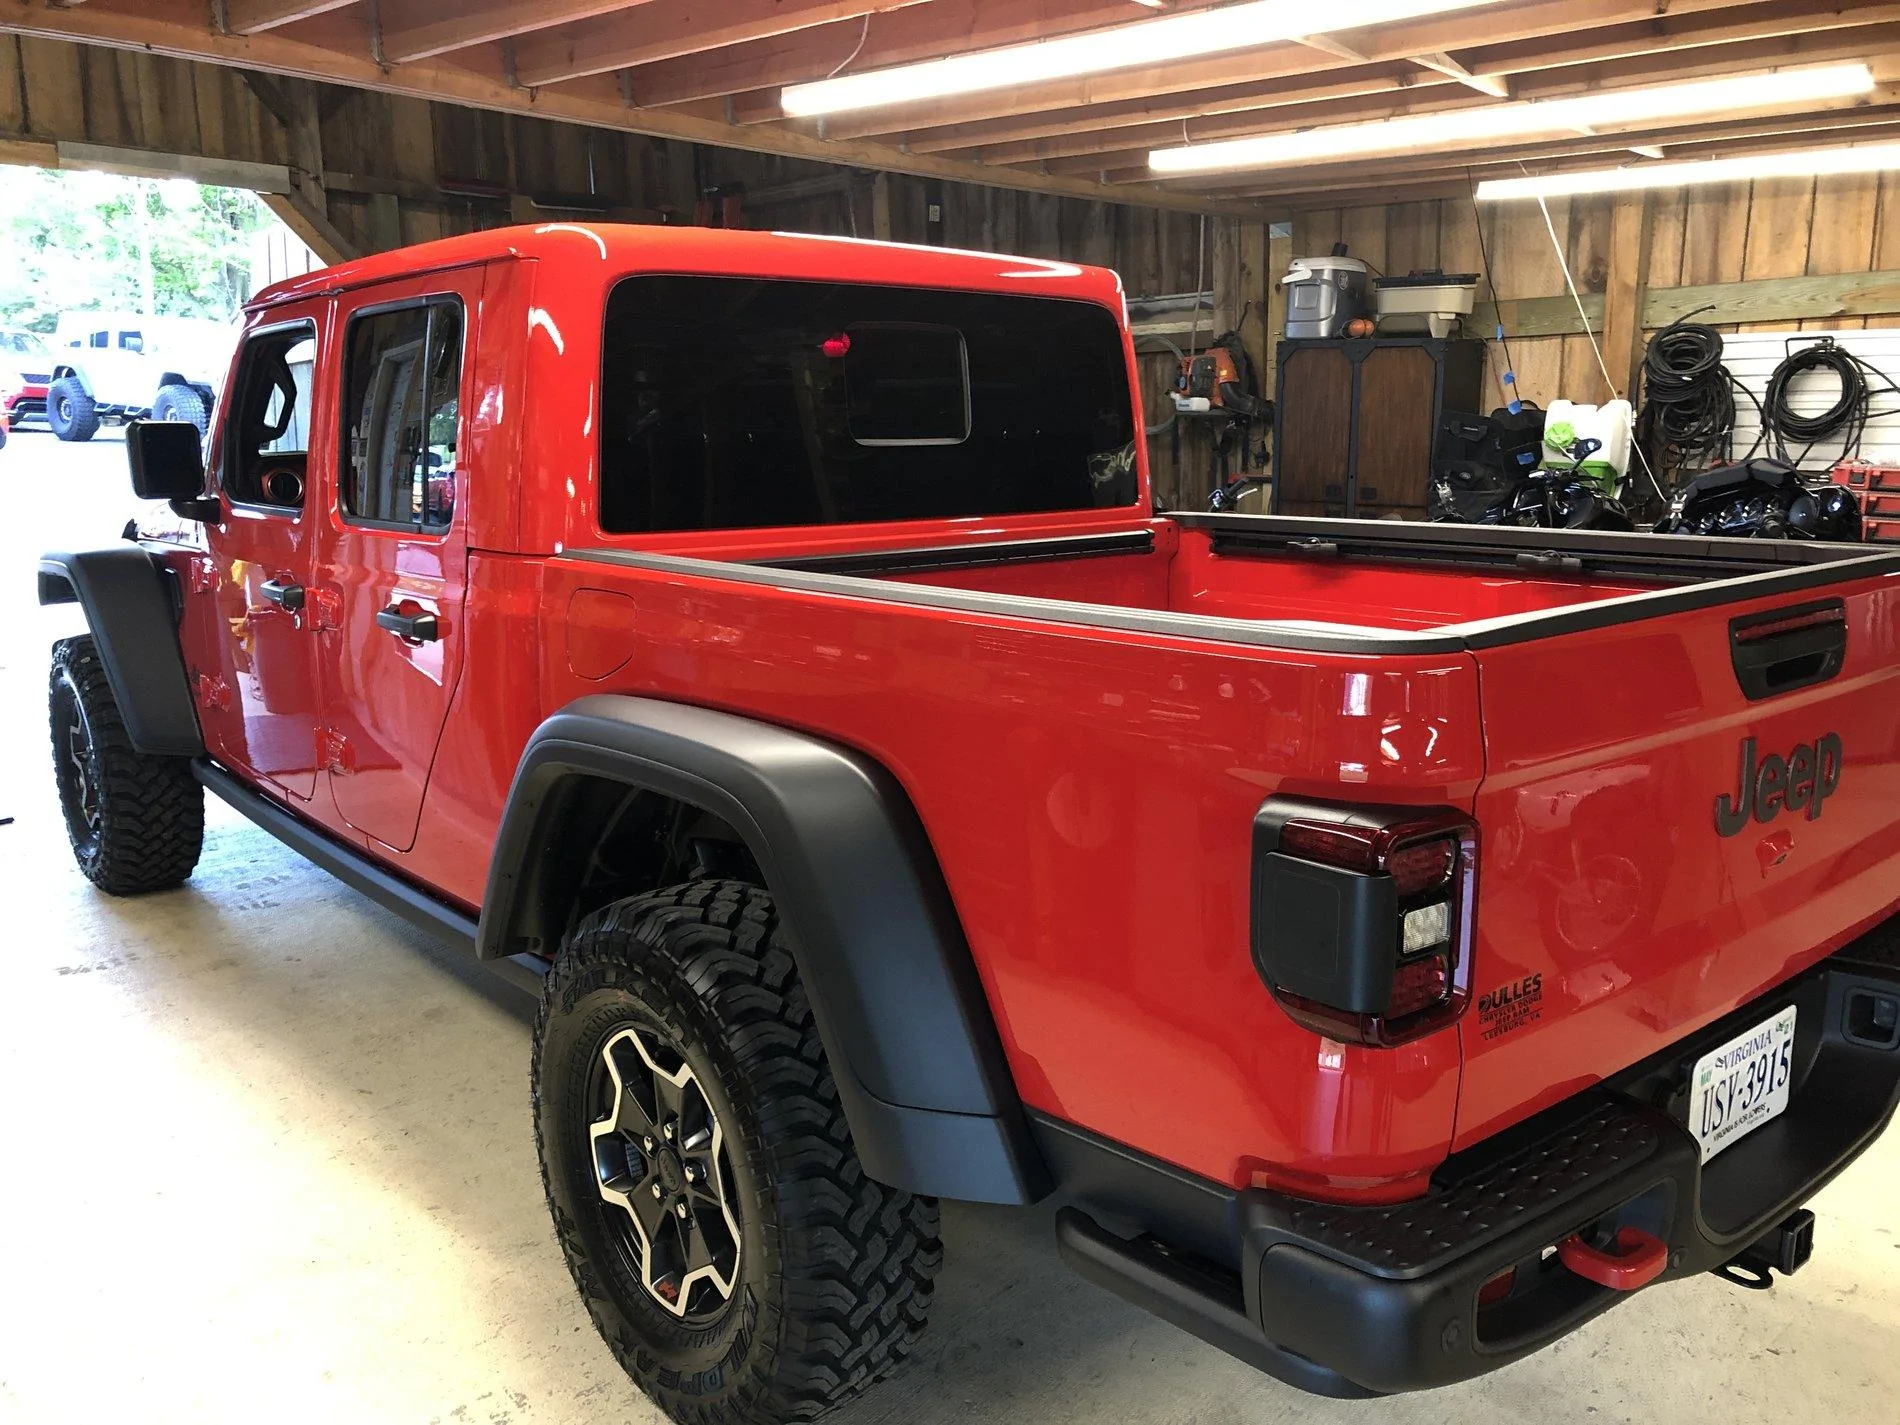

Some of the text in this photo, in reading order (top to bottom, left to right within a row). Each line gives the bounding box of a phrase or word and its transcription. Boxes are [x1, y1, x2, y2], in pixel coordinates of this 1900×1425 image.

[1714, 731, 1843, 838] Jeep
[1478, 973, 1542, 1013] DULLES
[1723, 1029, 1772, 1070] VIRGINIA
